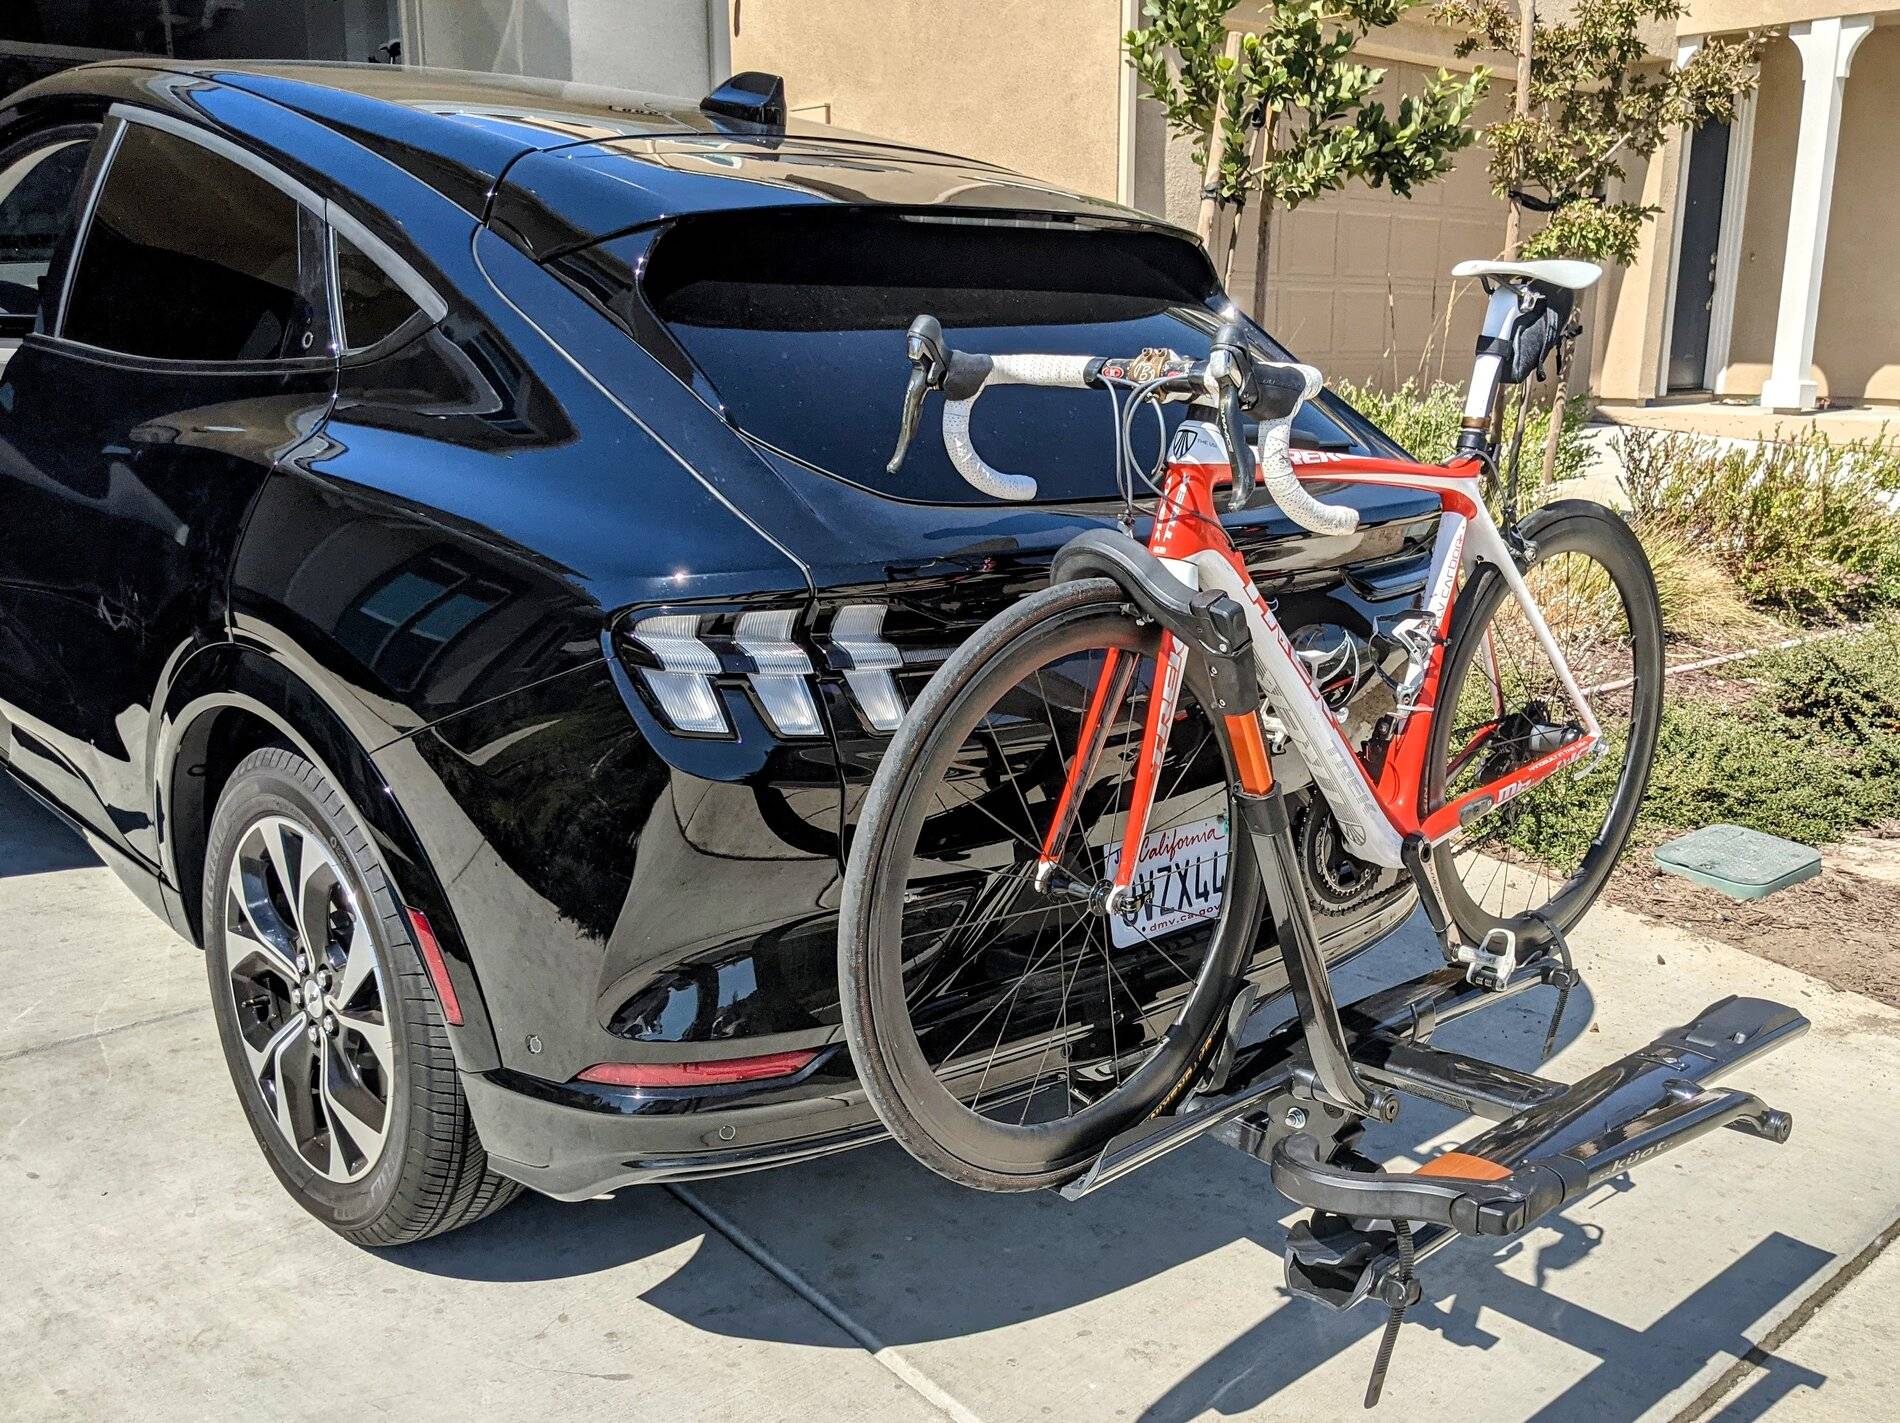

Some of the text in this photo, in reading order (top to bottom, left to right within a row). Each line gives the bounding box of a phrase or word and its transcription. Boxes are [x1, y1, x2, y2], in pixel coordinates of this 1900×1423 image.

[1287, 449, 1341, 466] REK
[1138, 824, 1226, 863] California
[1149, 905, 1221, 932] dmv.ca.gov
